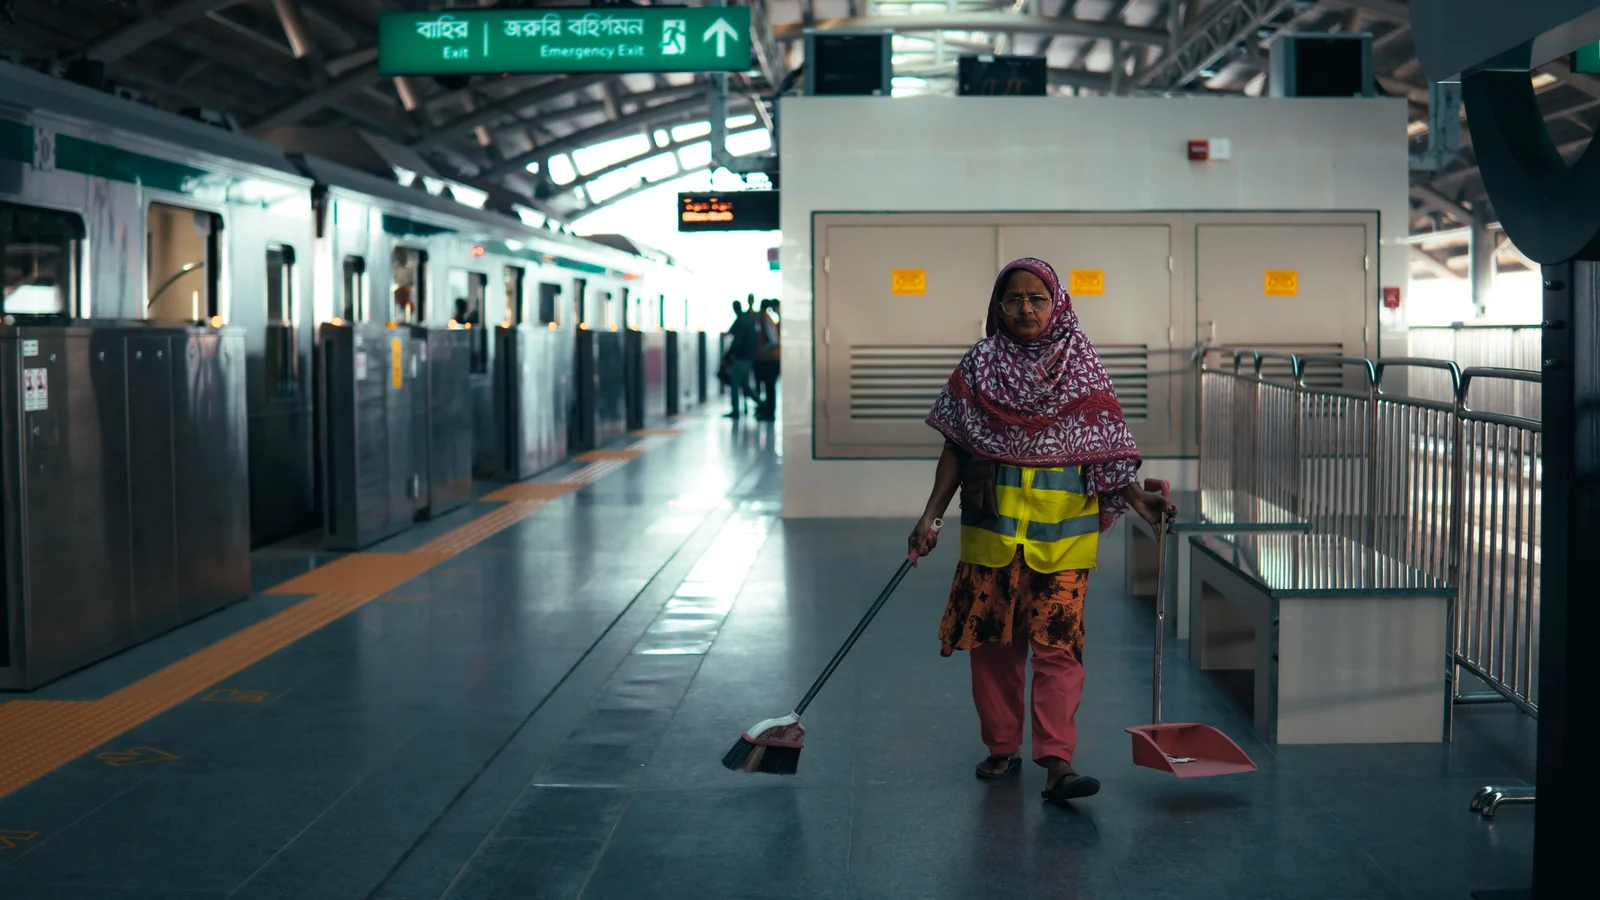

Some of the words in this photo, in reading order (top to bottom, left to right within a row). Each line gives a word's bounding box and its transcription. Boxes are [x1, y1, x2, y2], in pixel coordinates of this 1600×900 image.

[416, 14, 468, 39] বাহির
[502, 12, 562, 37] জরুরি
[567, 12, 644, 38] বহির্গমন
[442, 46, 469, 59] Exit
[540, 45, 615, 60] Emergency
[617, 45, 645, 57] Exit
